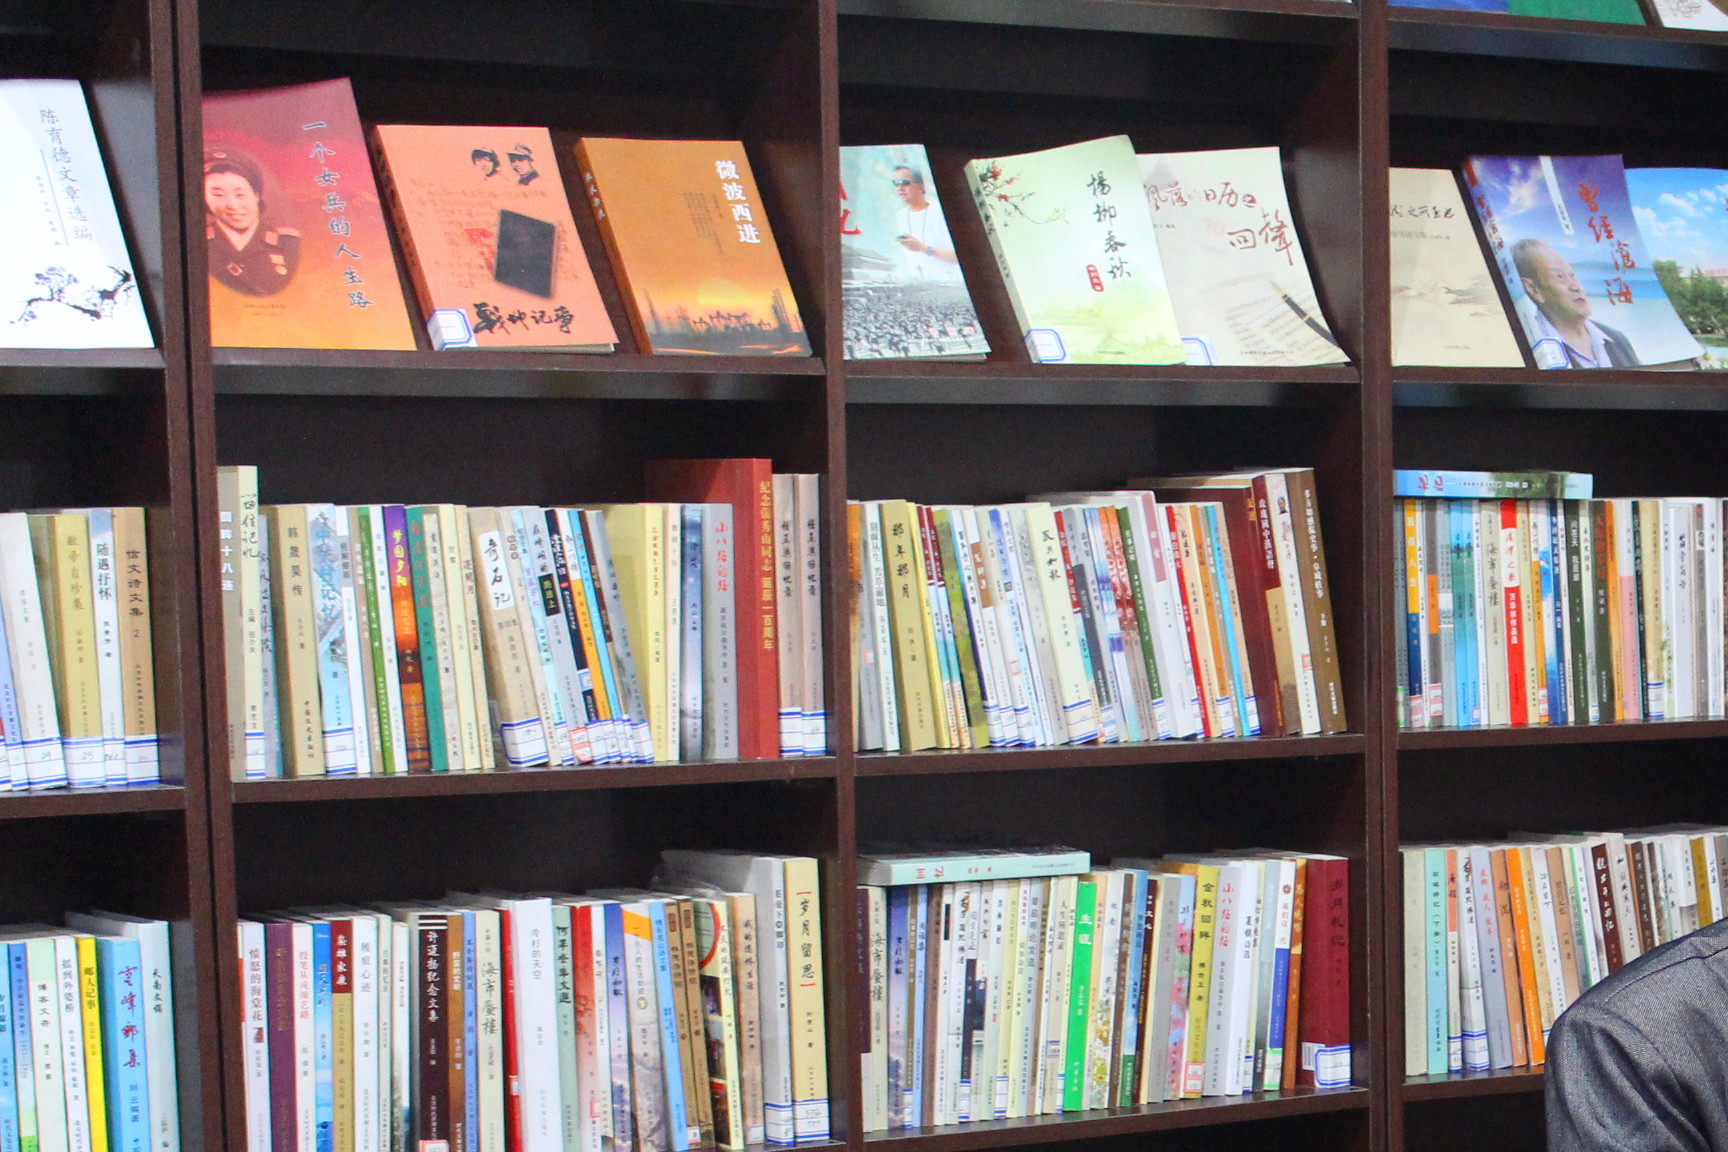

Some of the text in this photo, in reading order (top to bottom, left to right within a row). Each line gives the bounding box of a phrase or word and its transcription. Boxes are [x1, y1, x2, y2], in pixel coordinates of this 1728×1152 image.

[303, 120, 374, 310] 一个女兵的人生路
[715, 159, 762, 245] 微波西进
[1200, 882, 1215, 940] 金秋回眸
